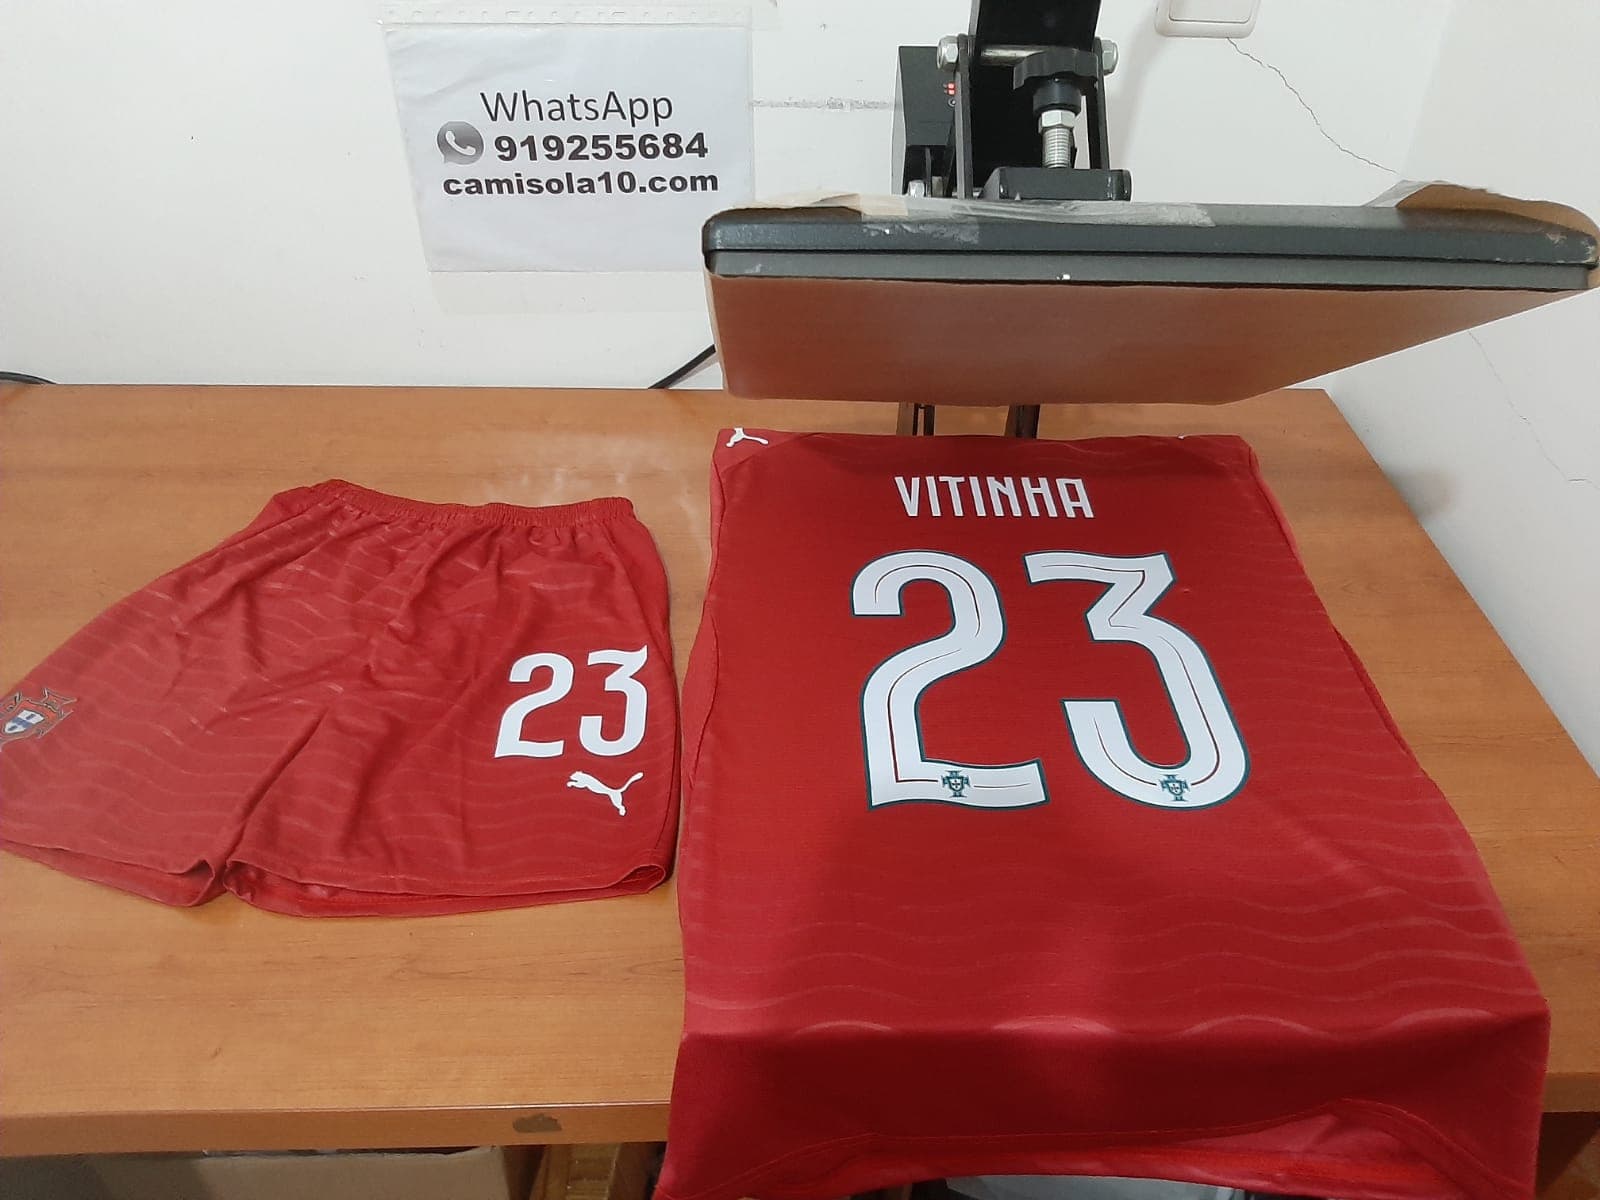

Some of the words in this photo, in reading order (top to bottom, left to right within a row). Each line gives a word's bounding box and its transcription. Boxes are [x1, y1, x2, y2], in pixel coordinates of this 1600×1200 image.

[480, 90, 673, 127] WhatsApp
[494, 132, 708, 162] 919255684
[443, 171, 718, 195] camisola10.com
[895, 475, 1095, 519] VITINHA
[850, 548, 1250, 811] 23
[494, 644, 648, 758] 23
